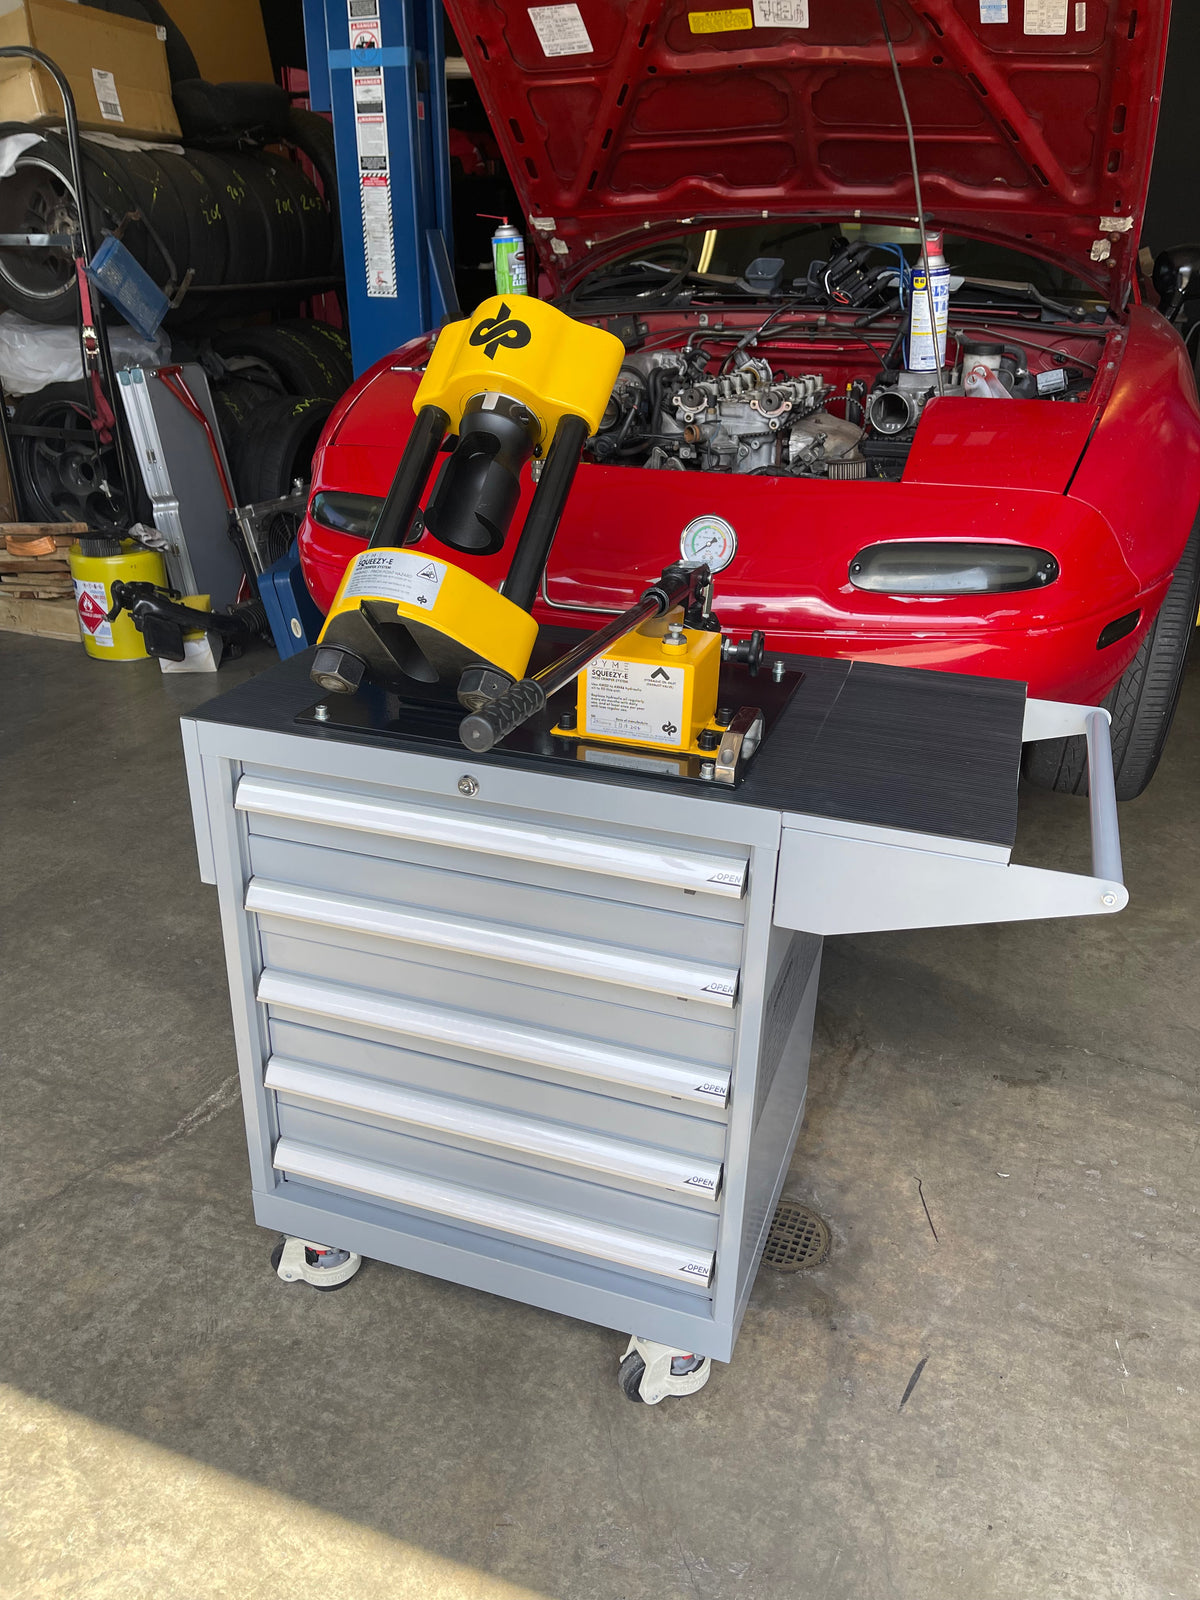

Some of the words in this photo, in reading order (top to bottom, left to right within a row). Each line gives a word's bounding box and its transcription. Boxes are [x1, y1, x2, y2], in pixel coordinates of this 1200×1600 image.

[358, 558, 394, 566] SQUEEZY-E
[591, 669, 628, 679] SQUEEZY-E
[716, 873, 742, 883] OPEN
[710, 982, 733, 993] OPEN
[703, 1083, 726, 1094] OPEN
[692, 1176, 714, 1186] OPEN
[687, 1264, 709, 1274] OPEN
